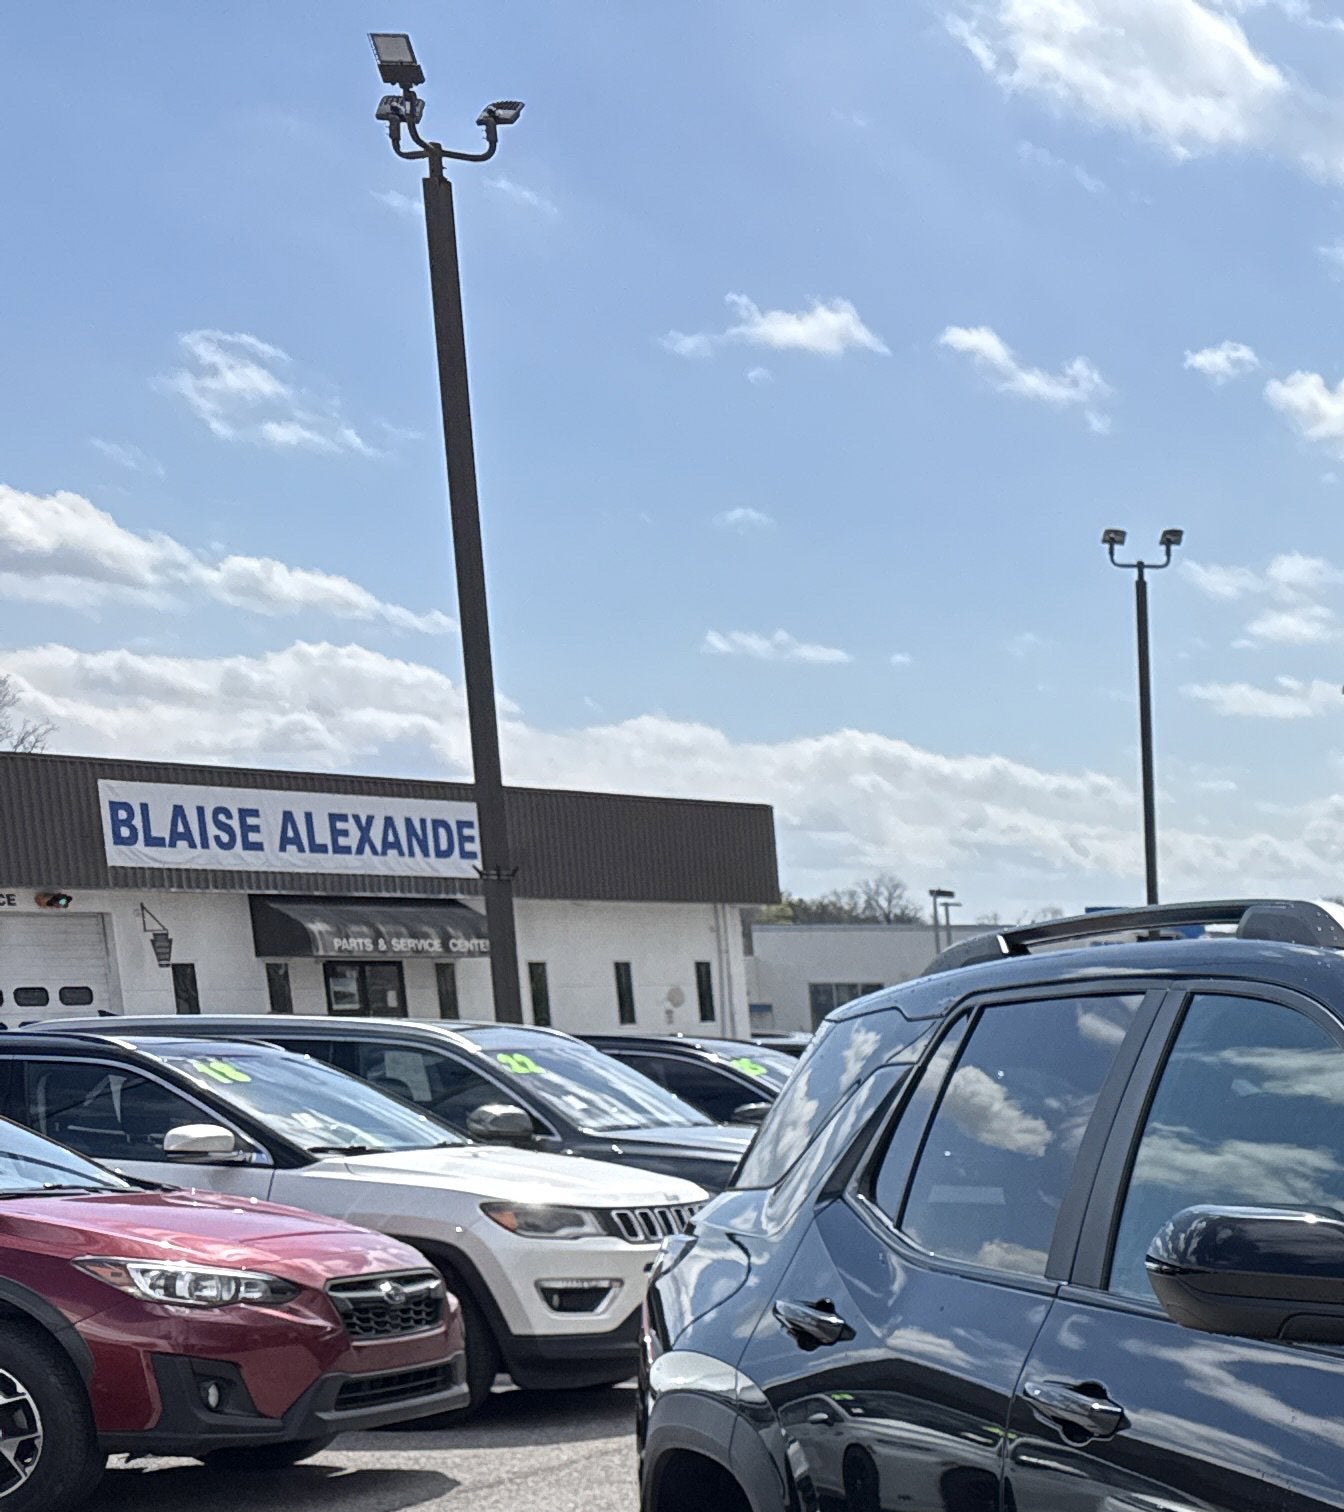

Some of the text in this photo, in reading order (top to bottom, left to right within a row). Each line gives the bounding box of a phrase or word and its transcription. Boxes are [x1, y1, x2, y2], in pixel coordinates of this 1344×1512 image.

[108, 800, 479, 861] BLAISE ALEXANDE
[332, 937, 491, 952] PARTS & SERVICE CENTE
